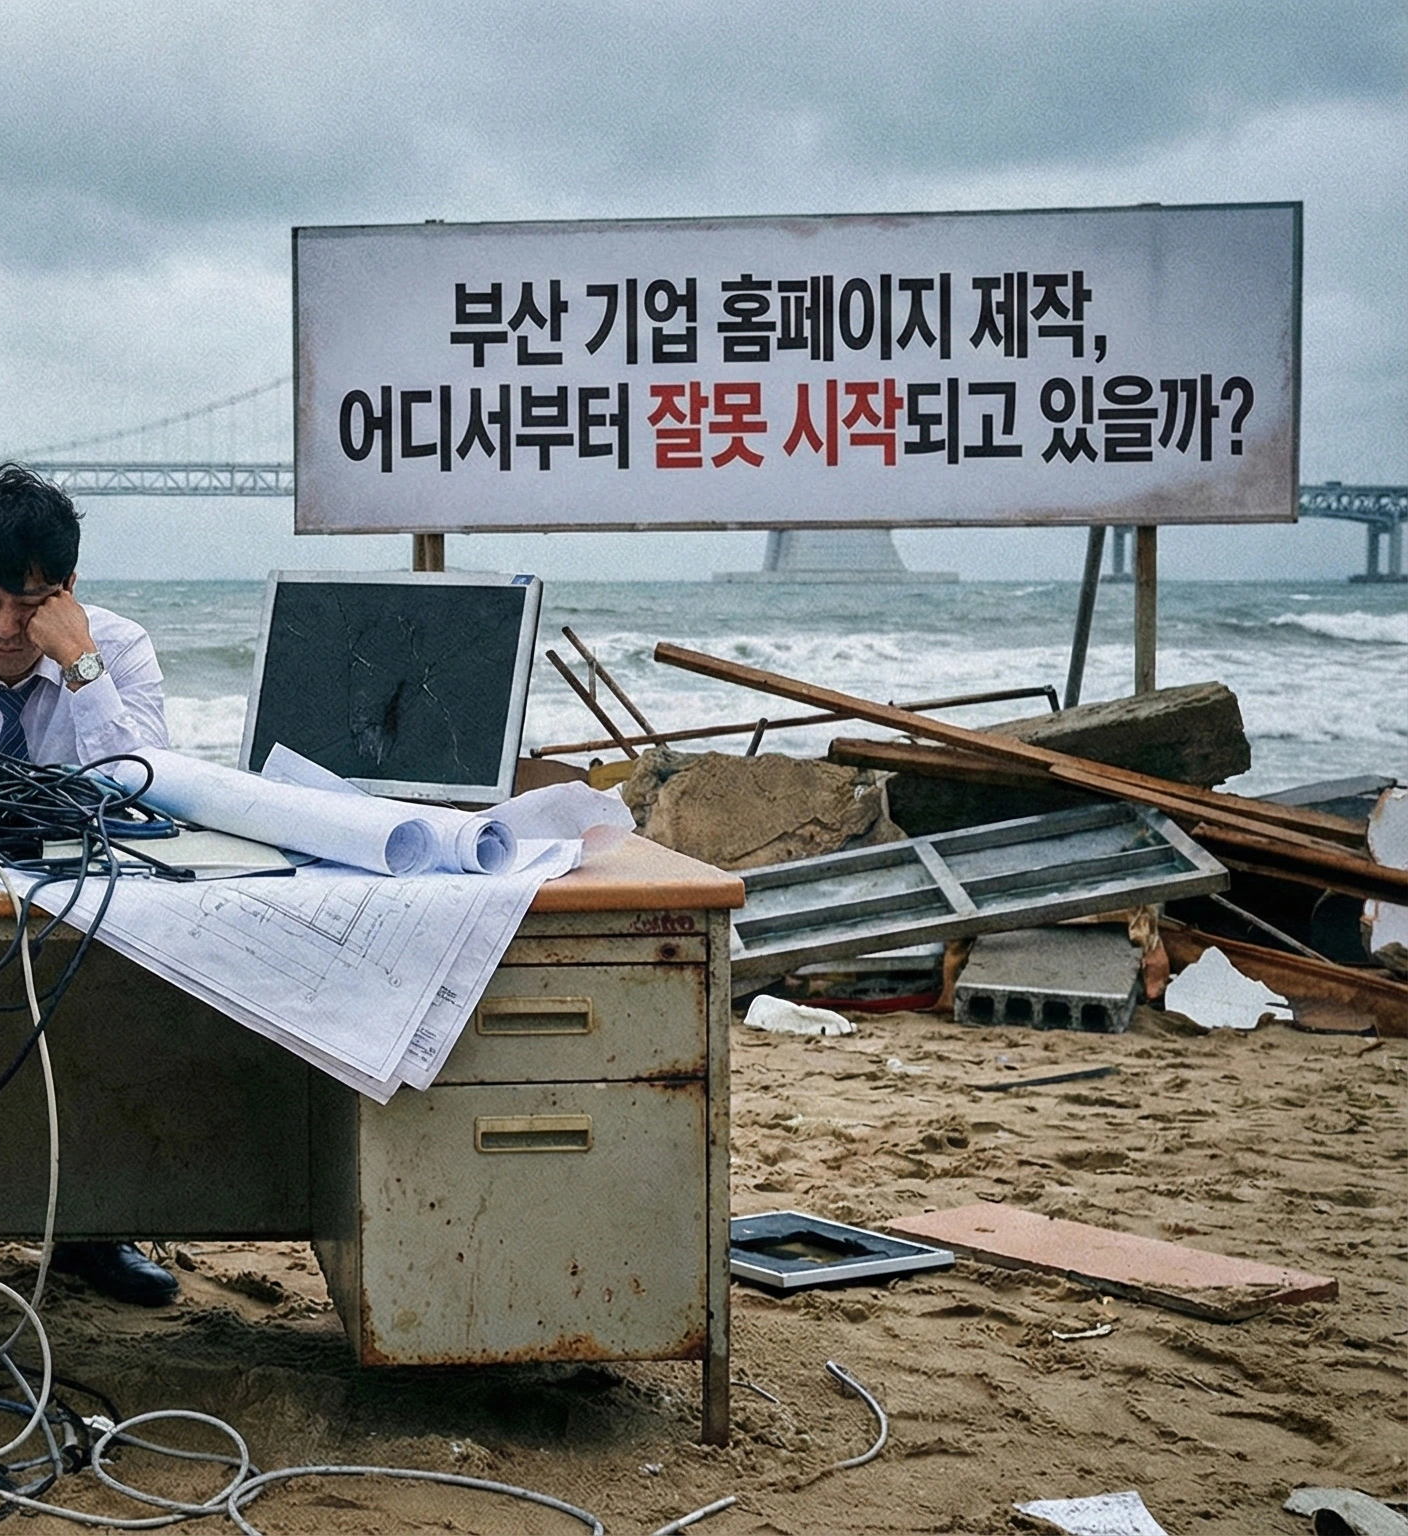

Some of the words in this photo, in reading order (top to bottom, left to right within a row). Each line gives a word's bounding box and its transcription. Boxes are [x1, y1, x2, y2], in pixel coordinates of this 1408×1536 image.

[450, 279, 569, 368] 부산
[585, 277, 698, 365] 기업
[717, 272, 951, 363] 홈페이지
[969, 270, 1108, 364] 제작,
[339, 382, 630, 473] 어디서부터
[647, 381, 767, 469] 잘못
[783, 377, 1023, 467] 시작되고
[1039, 373, 1255, 465] 있을까?
